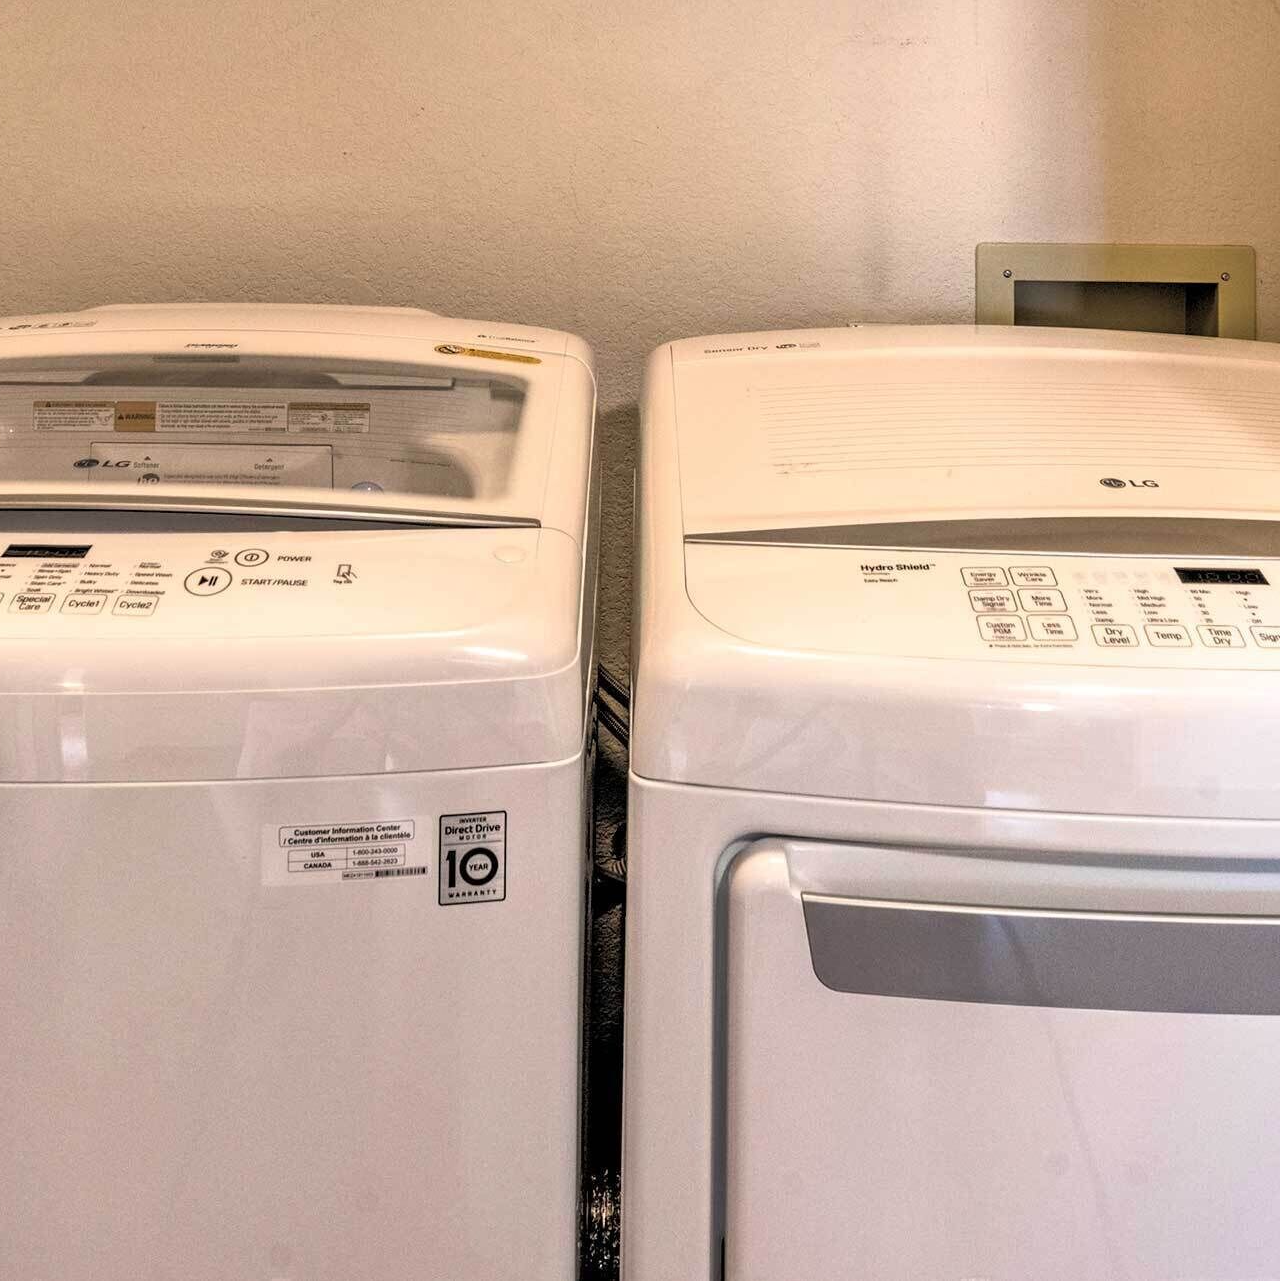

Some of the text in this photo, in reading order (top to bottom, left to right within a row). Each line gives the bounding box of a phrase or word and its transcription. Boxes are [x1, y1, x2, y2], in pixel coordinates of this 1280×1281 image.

[102, 460, 131, 468] LG
[1128, 479, 1160, 488] LG
[277, 555, 312, 563] POWER
[860, 564, 894, 572] Hydro
[240, 578, 309, 587] START/PAUSE
[16, 595, 52, 604] Special
[68, 599, 100, 609] Cycle1
[18, 601, 41, 611] Care
[119, 600, 152, 610] Cycle2
[985, 621, 1016, 629] Custom
[1104, 627, 1123, 637] Dry
[1153, 631, 1182, 641] Temp
[1208, 628, 1232, 637] Time
[1103, 636, 1130, 645] Level
[1213, 636, 1231, 646] Dry
[459, 816, 487, 824] INVERTER
[294, 823, 401, 836] Customer Information Center
[444, 823, 501, 836] Direct Drive
[288, 836, 313, 845] Centre
[314, 834, 363, 844] d'information
[310, 851, 325, 859] USA
[303, 861, 332, 870] CANADA
[446, 847, 499, 888] 10
[469, 863, 489, 872] YEAR
[448, 889, 497, 899] WARRANTY
